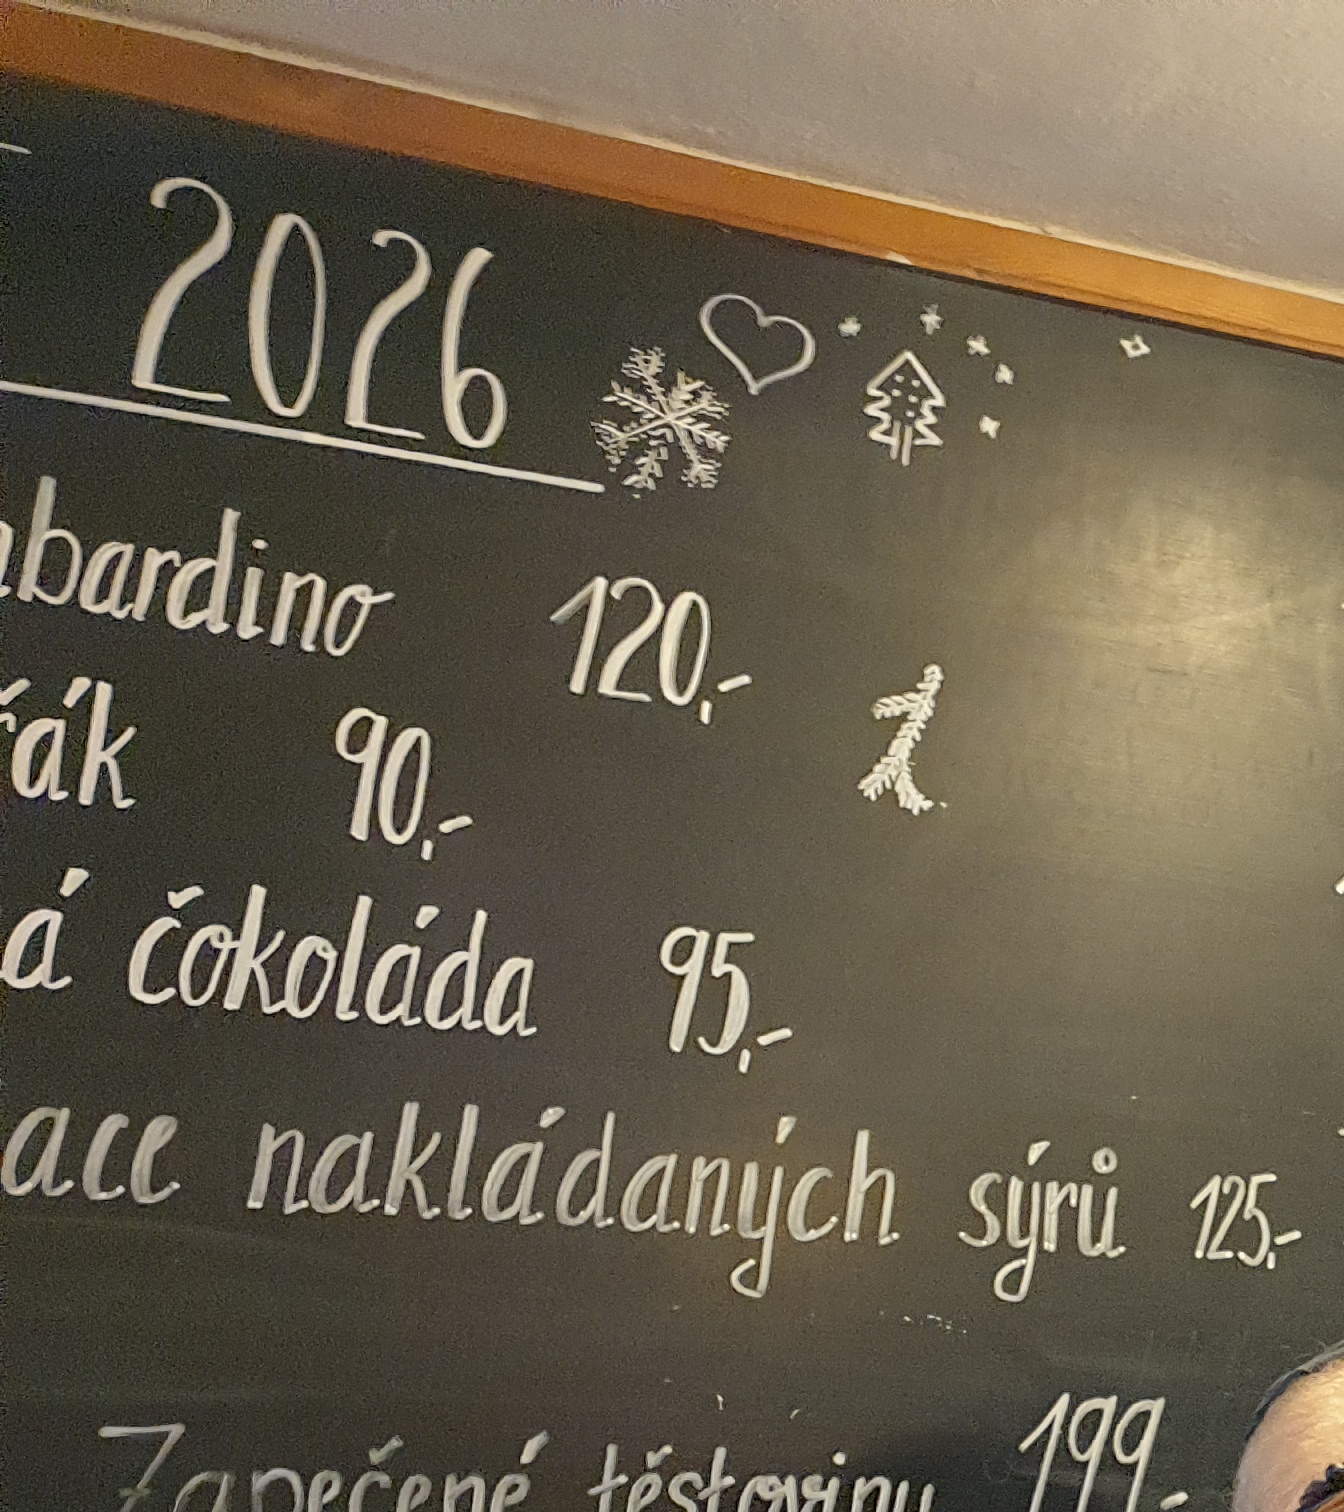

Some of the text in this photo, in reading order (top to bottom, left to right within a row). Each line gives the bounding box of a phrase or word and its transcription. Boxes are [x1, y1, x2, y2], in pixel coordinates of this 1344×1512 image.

[131, 176, 507, 449] 2026
[551, 576, 752, 725] 120,-
[335, 707, 473, 860] 90,-
[128, 884, 538, 1037] čokoláda
[659, 925, 793, 1073] 95,-
[246, 1101, 900, 1299] nakládaných
[959, 1140, 1126, 1302] sýrů
[1190, 1173, 1301, 1269] 125,-
